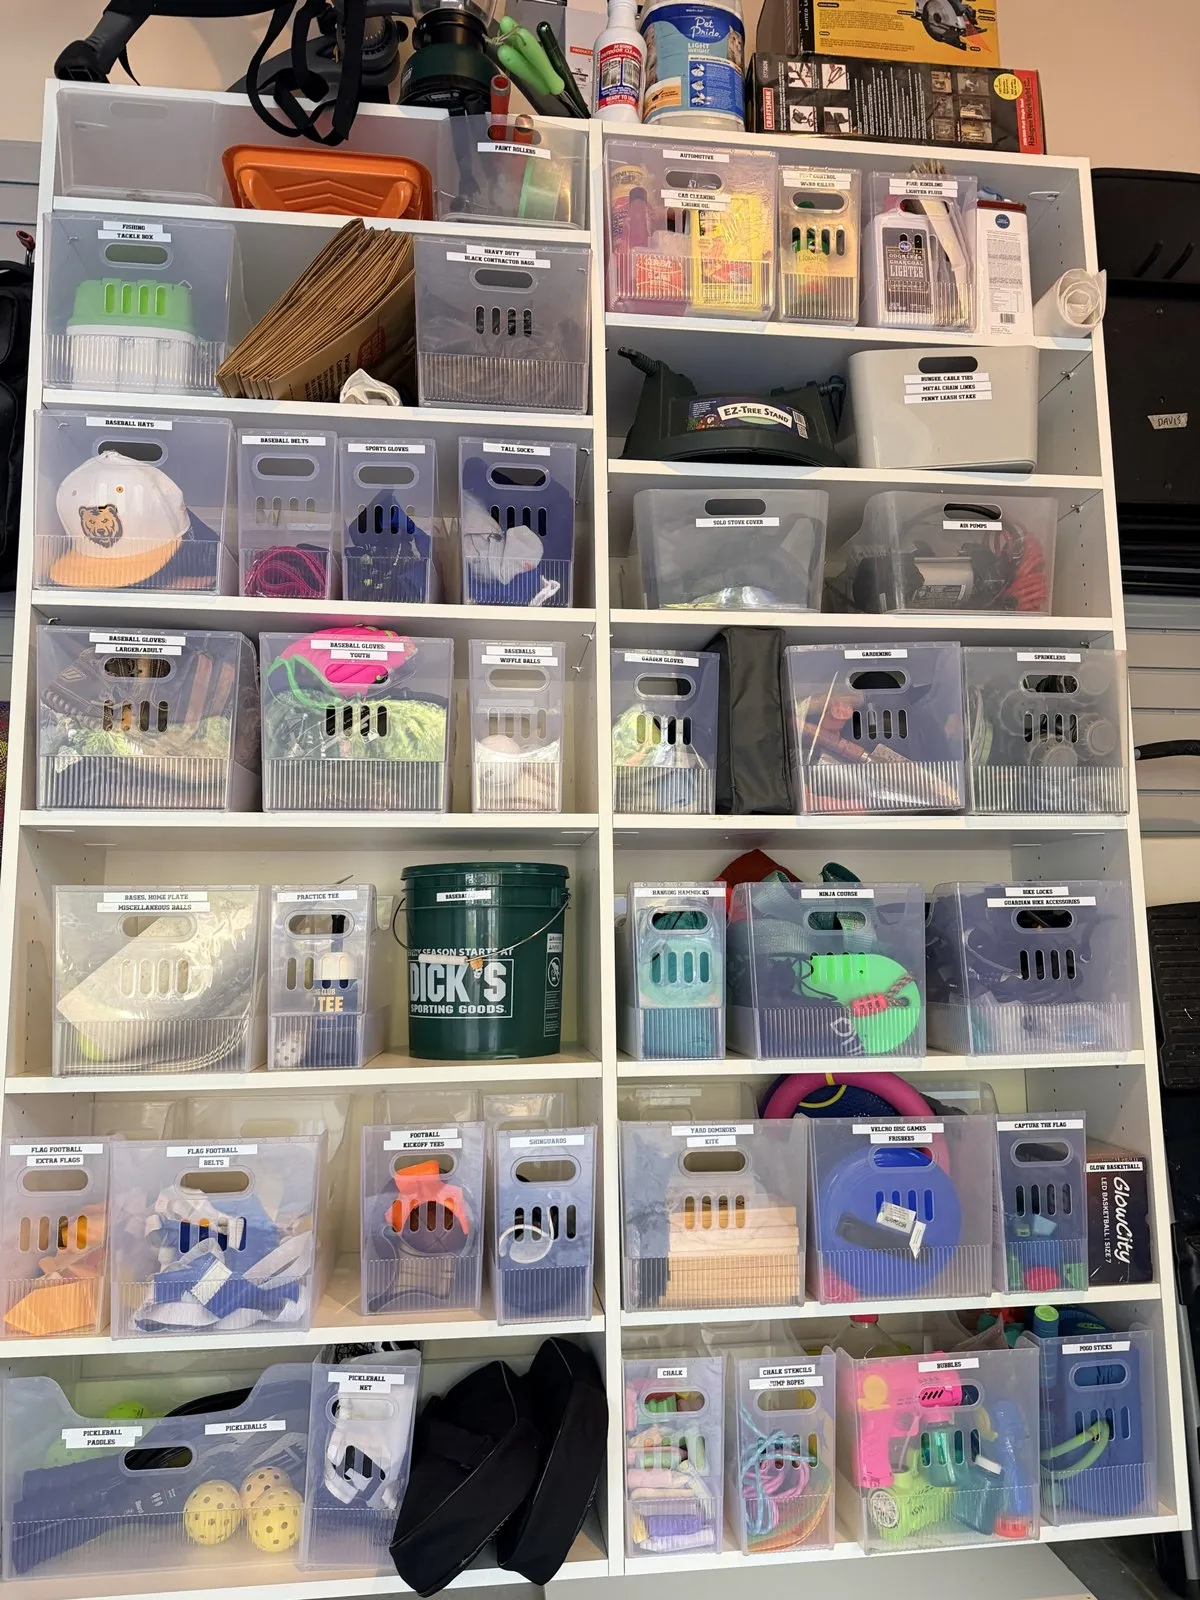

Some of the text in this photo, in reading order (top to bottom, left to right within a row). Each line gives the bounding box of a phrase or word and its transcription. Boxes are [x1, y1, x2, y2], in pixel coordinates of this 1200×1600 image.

[694, 15, 715, 29] Pet
[690, 25, 720, 39] Pride
[765, 89, 773, 128] CRAFTSMAN
[494, 144, 536, 155] PAINT ROLLERS
[679, 152, 715, 161] AUTOMOTIVE
[689, 193, 716, 201] CLEANING
[122, 223, 146, 231] FISHING
[484, 248, 520, 257] HEAVY DUTY
[483, 257, 520, 265] CONTRACTOR
[889, 264, 924, 278] LIGHTER
[105, 419, 137, 427] BASEBALL
[1156, 415, 1182, 427] DAVIS
[108, 635, 141, 643] BASEBALL
[115, 646, 164, 654] LARGER/ADULT
[171, 903, 192, 911] BALLS
[422, 948, 457, 957] SEASON
[458, 947, 499, 957] STARTS
[500, 947, 515, 956] AT
[321, 988, 336, 996] CLUB
[317, 996, 344, 1013] TEE
[410, 1004, 454, 1014] SPORTING
[707, 1126, 737, 1134] DOMINOES
[906, 1124, 927, 1132] GAMES
[409, 1131, 441, 1139] FOOTBALL
[402, 1141, 429, 1149] KICKOFF
[528, 1137, 567, 1145] SHINGUARDS
[31, 1146, 49, 1154] FLAG
[205, 1146, 239, 1154] FOOTBALL
[1106, 1163, 1141, 1171] BASKETBALL
[1100, 1176, 1108, 1191] LED
[1101, 1191, 1111, 1238] BASKETBALL
[1113, 1176, 1134, 1265] GlowCity
[1104, 1241, 1112, 1259] SIZE
[936, 1361, 962, 1369] BUBBLES
[662, 1369, 683, 1377] CHALK
[762, 1366, 813, 1376] CHALK STENCILS
[348, 1374, 386, 1382] PICKLEBALL
[225, 1423, 268, 1432] PICKLEBALLS
[83, 1429, 123, 1437] PICKLEBALL
[86, 1438, 116, 1446] PADDLES
